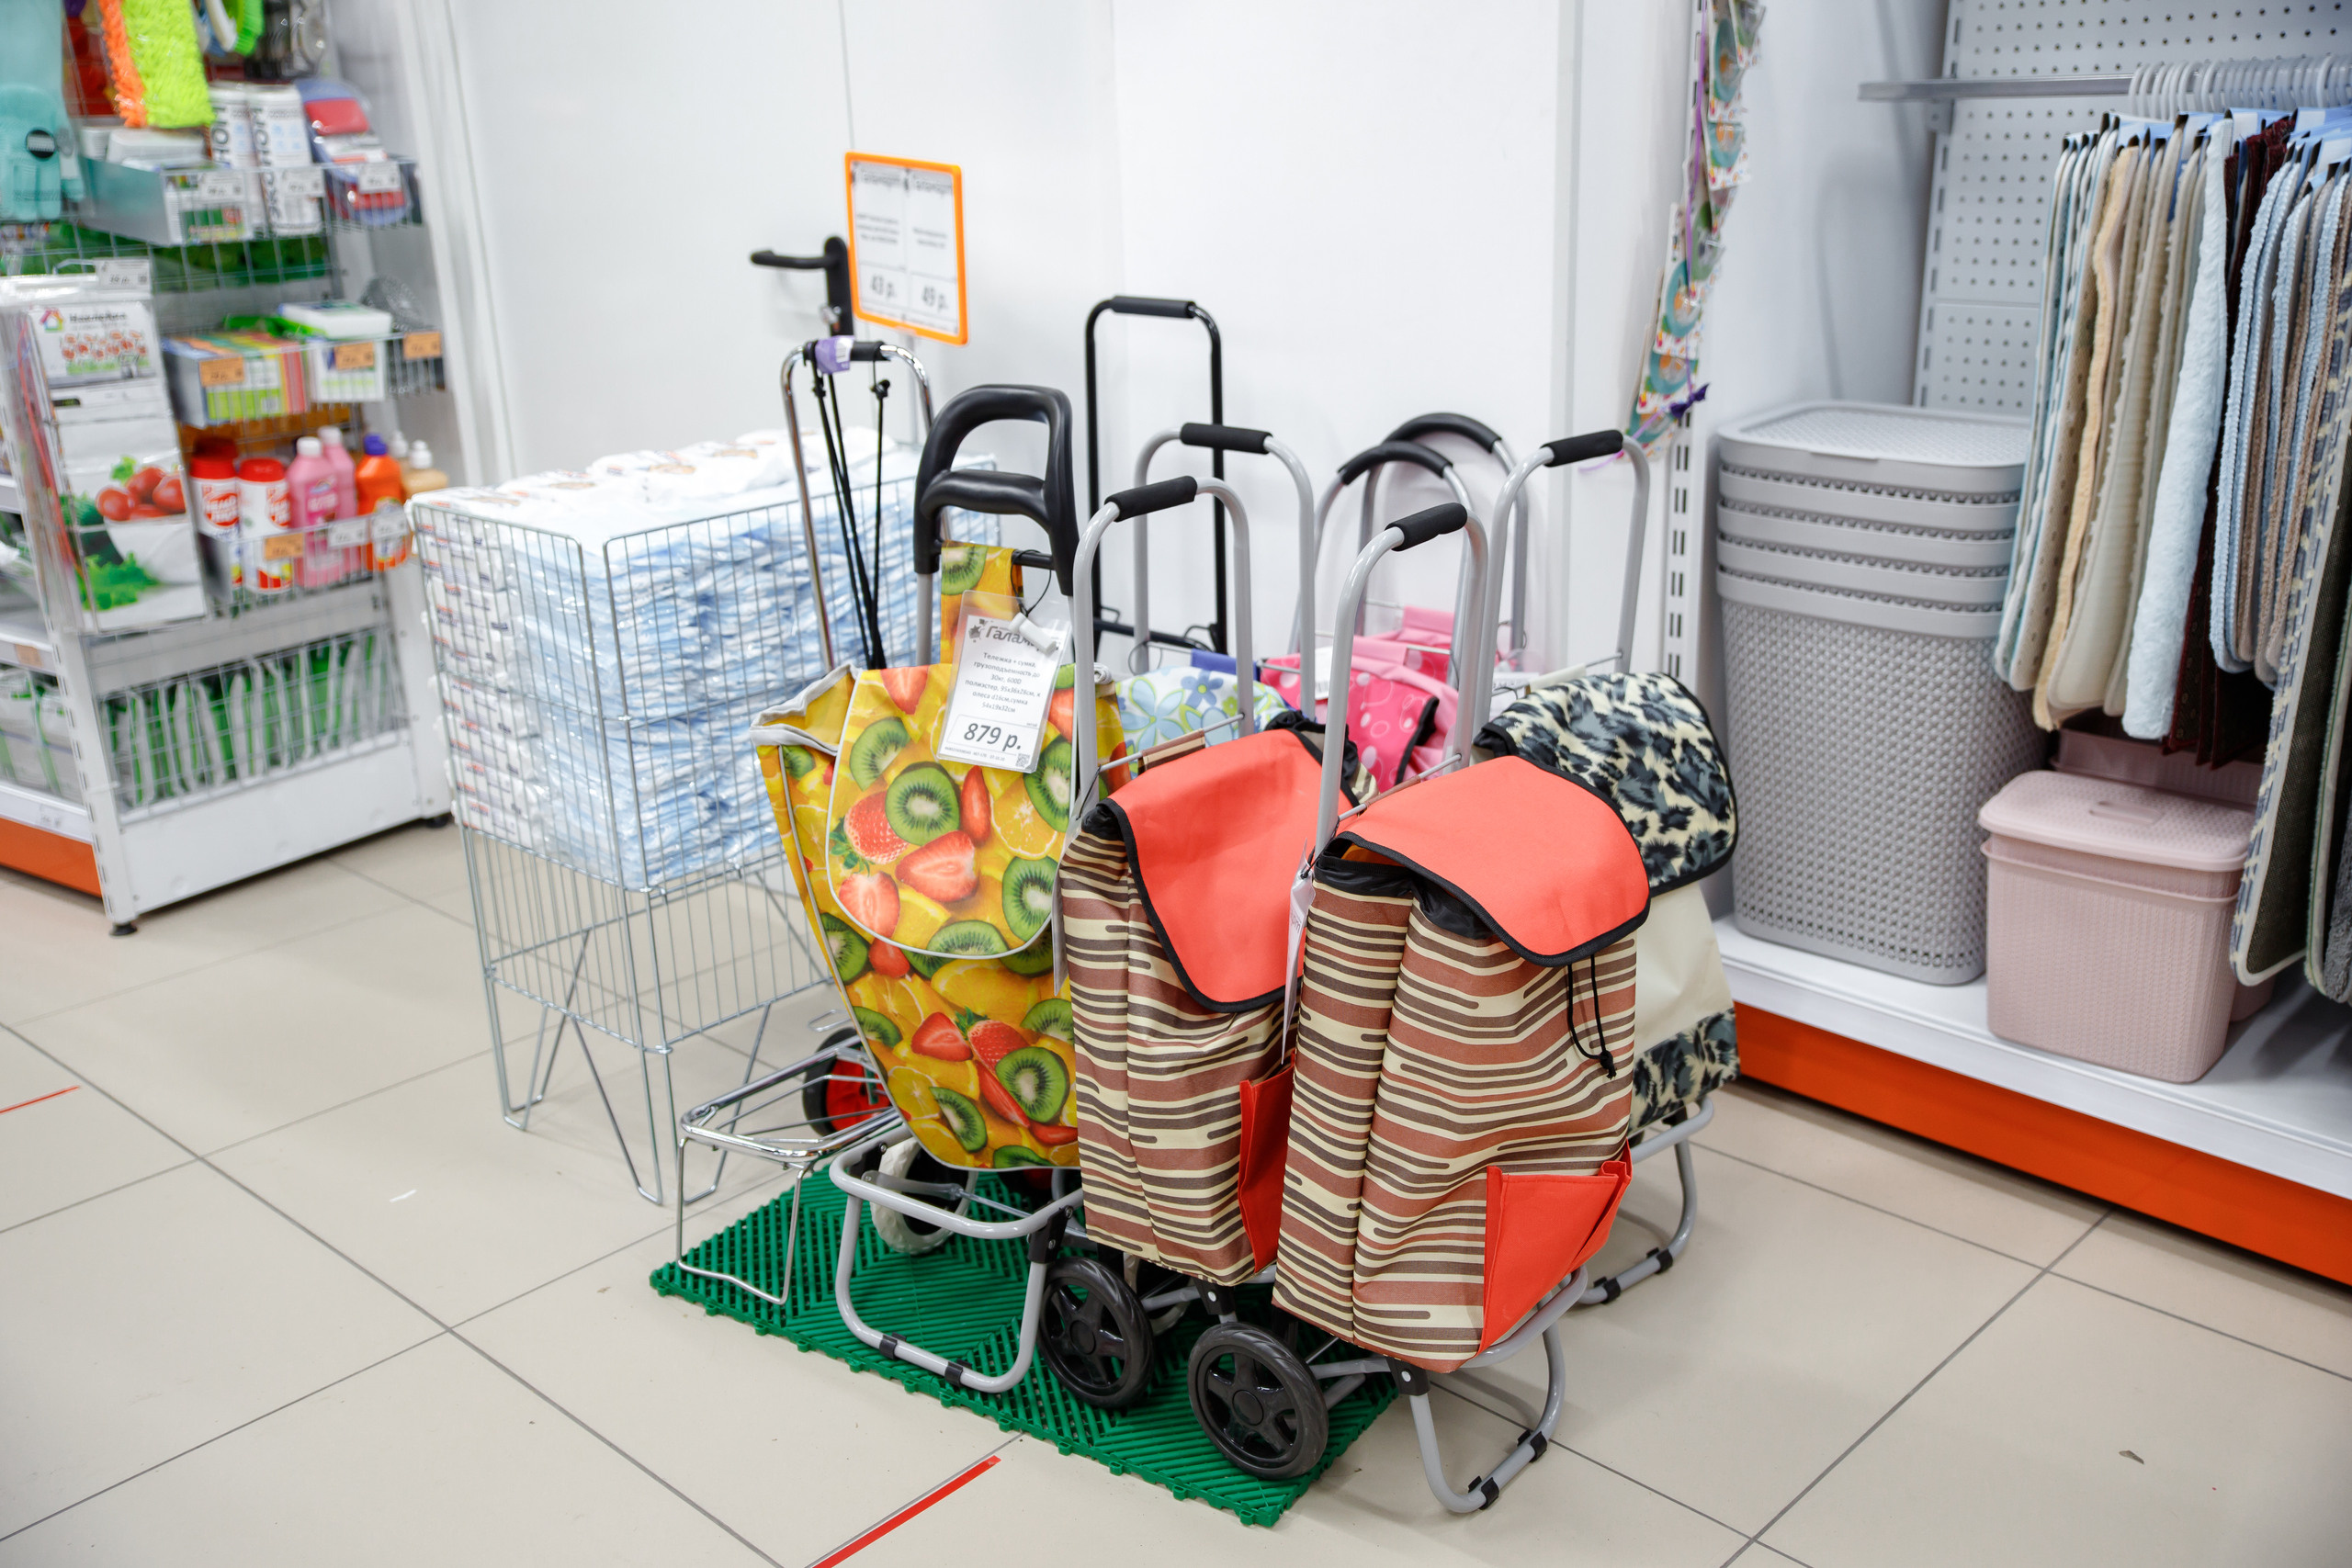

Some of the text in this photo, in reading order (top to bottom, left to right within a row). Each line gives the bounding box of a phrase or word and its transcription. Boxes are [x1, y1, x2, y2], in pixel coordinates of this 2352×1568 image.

[983, 652, 1012, 664] Тележка
[974, 661, 1031, 677] грузоподъемность
[965, 680, 999, 692] полиэстер,
[964, 723, 1021, 751] 879 р.
